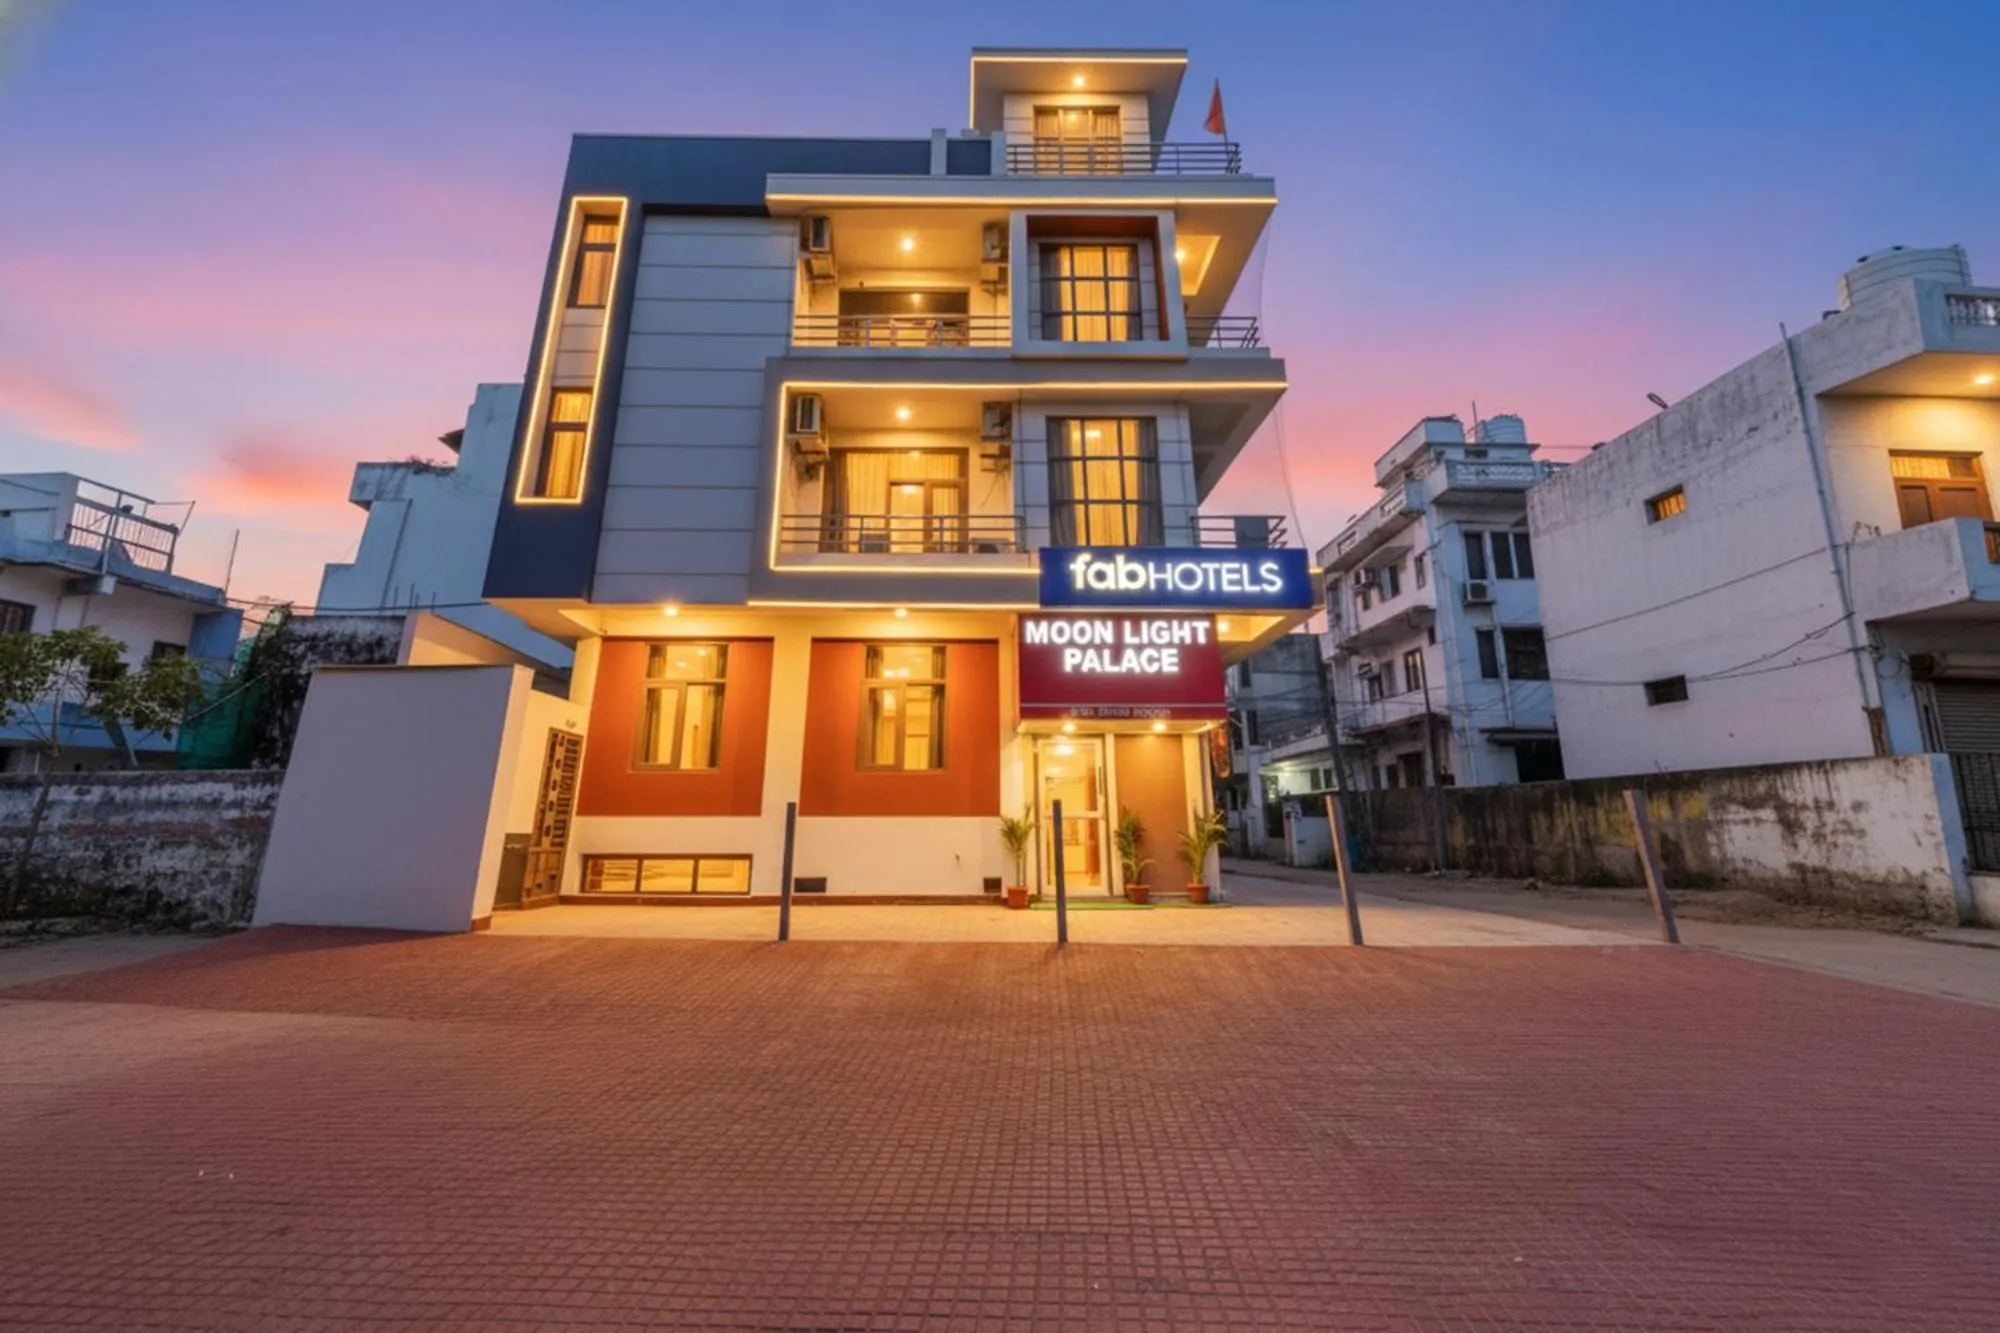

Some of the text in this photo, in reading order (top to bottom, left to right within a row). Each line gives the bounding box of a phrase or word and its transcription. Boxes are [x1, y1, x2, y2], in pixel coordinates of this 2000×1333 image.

[1025, 621, 1209, 644] MOON LIGHT
[1064, 648, 1179, 673] PALACE
